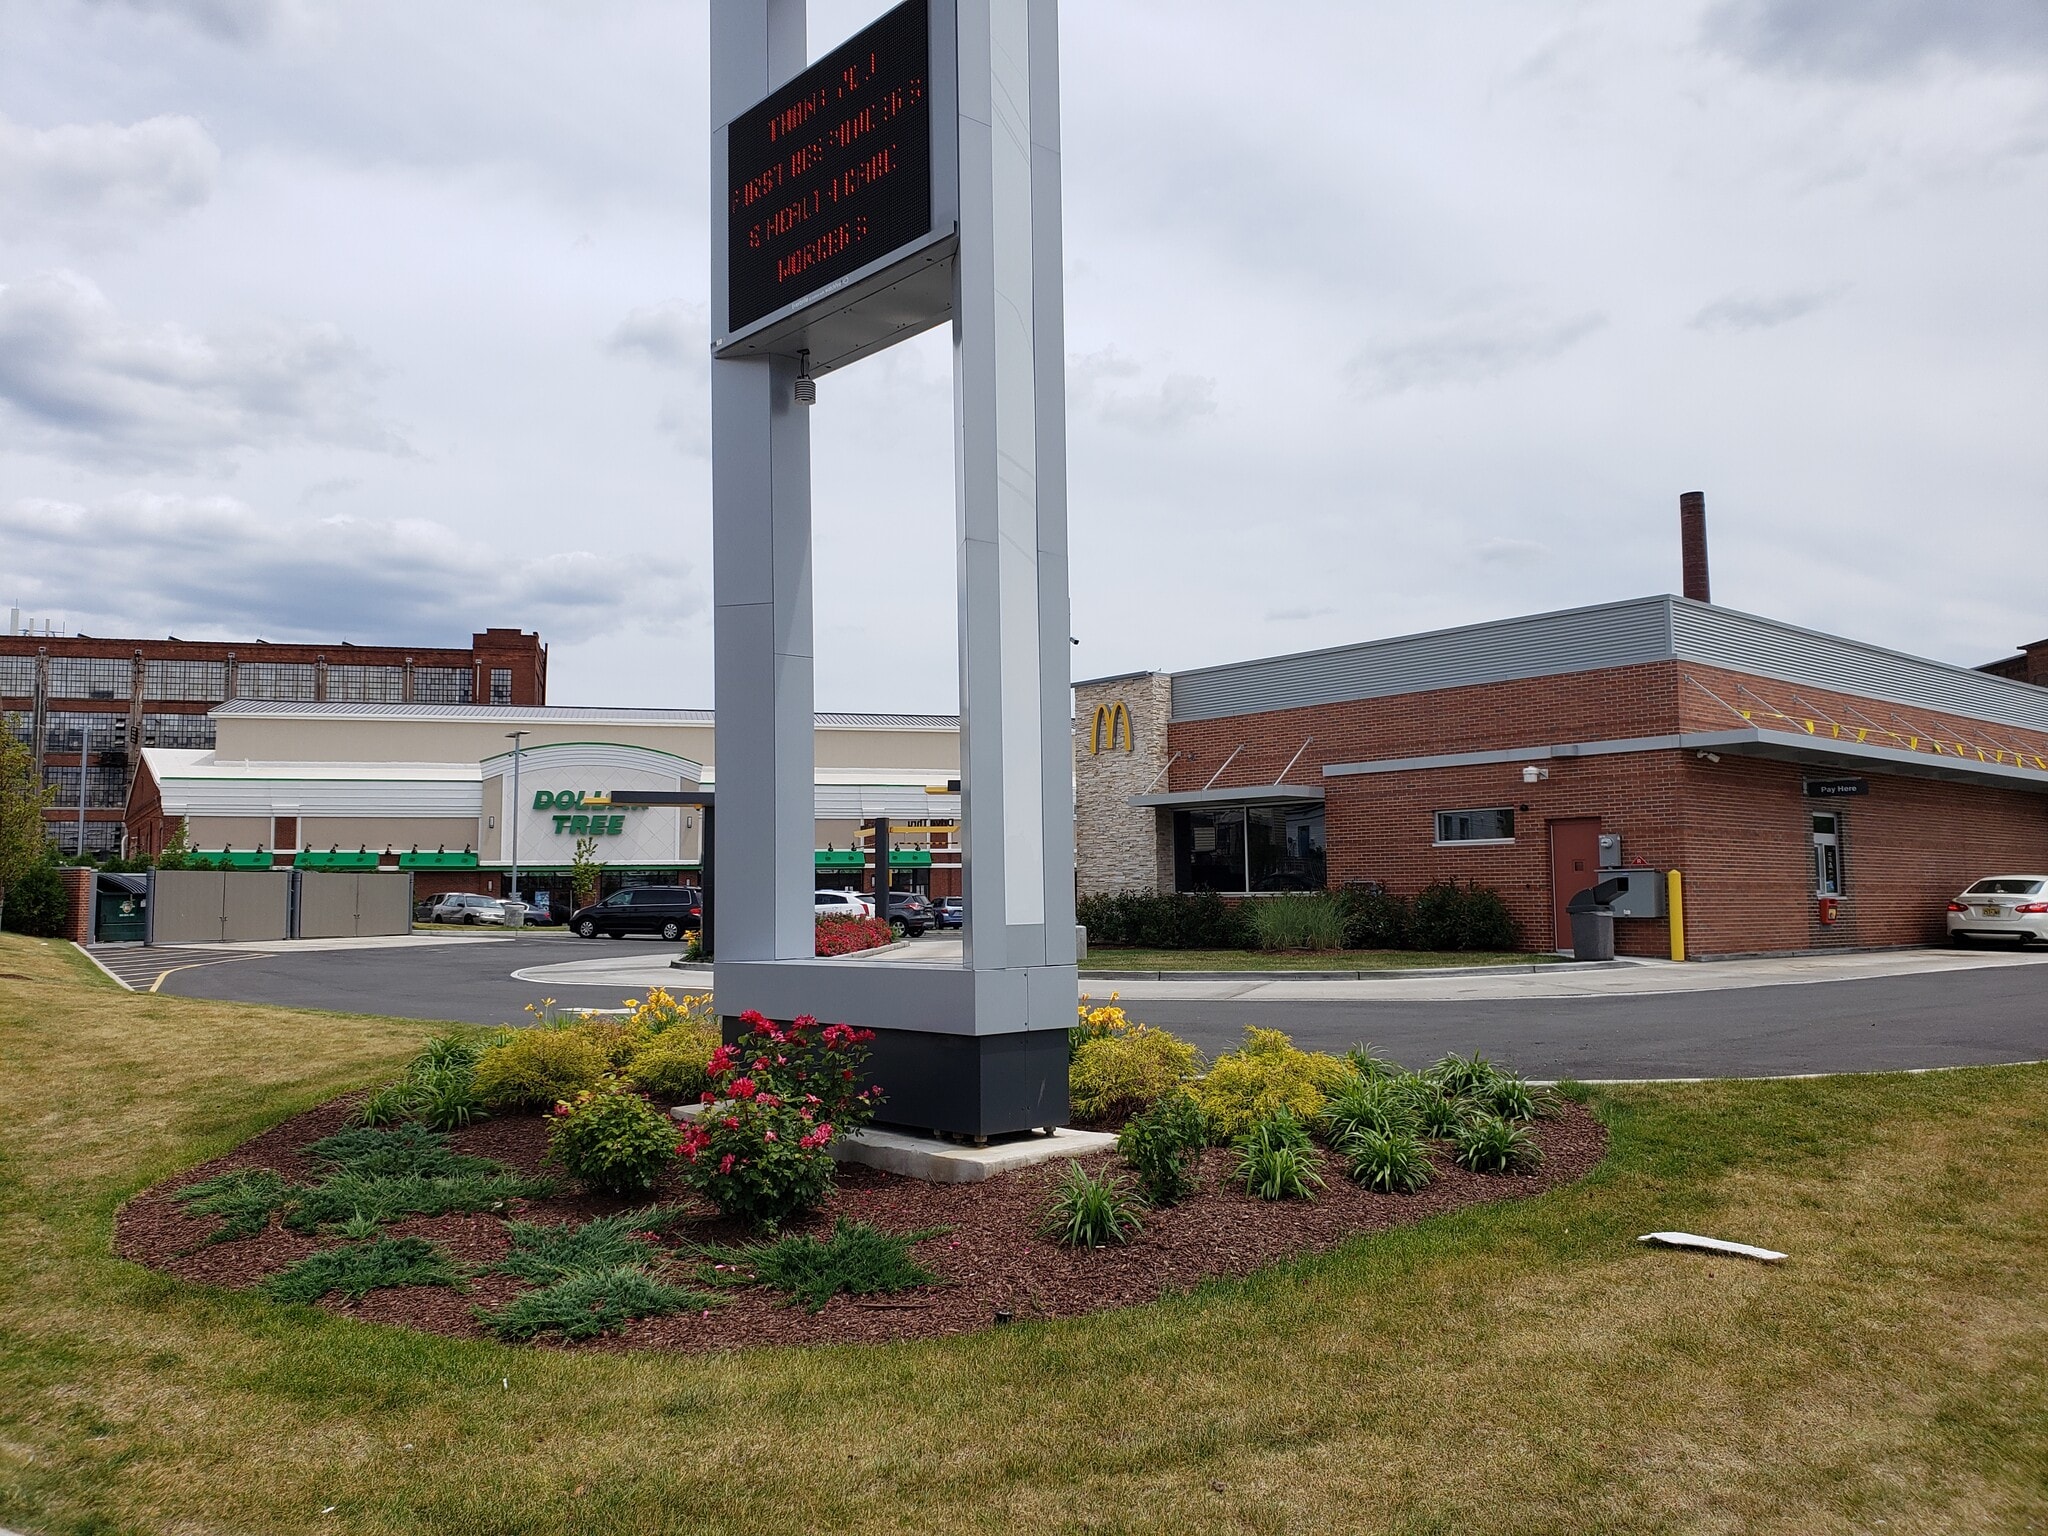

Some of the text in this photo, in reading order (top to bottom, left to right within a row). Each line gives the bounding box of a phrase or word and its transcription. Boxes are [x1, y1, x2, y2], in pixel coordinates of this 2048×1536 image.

[532, 790, 649, 811] DOLL
[1821, 785, 1857, 795] Pay Here
[552, 815, 626, 836] TREE
